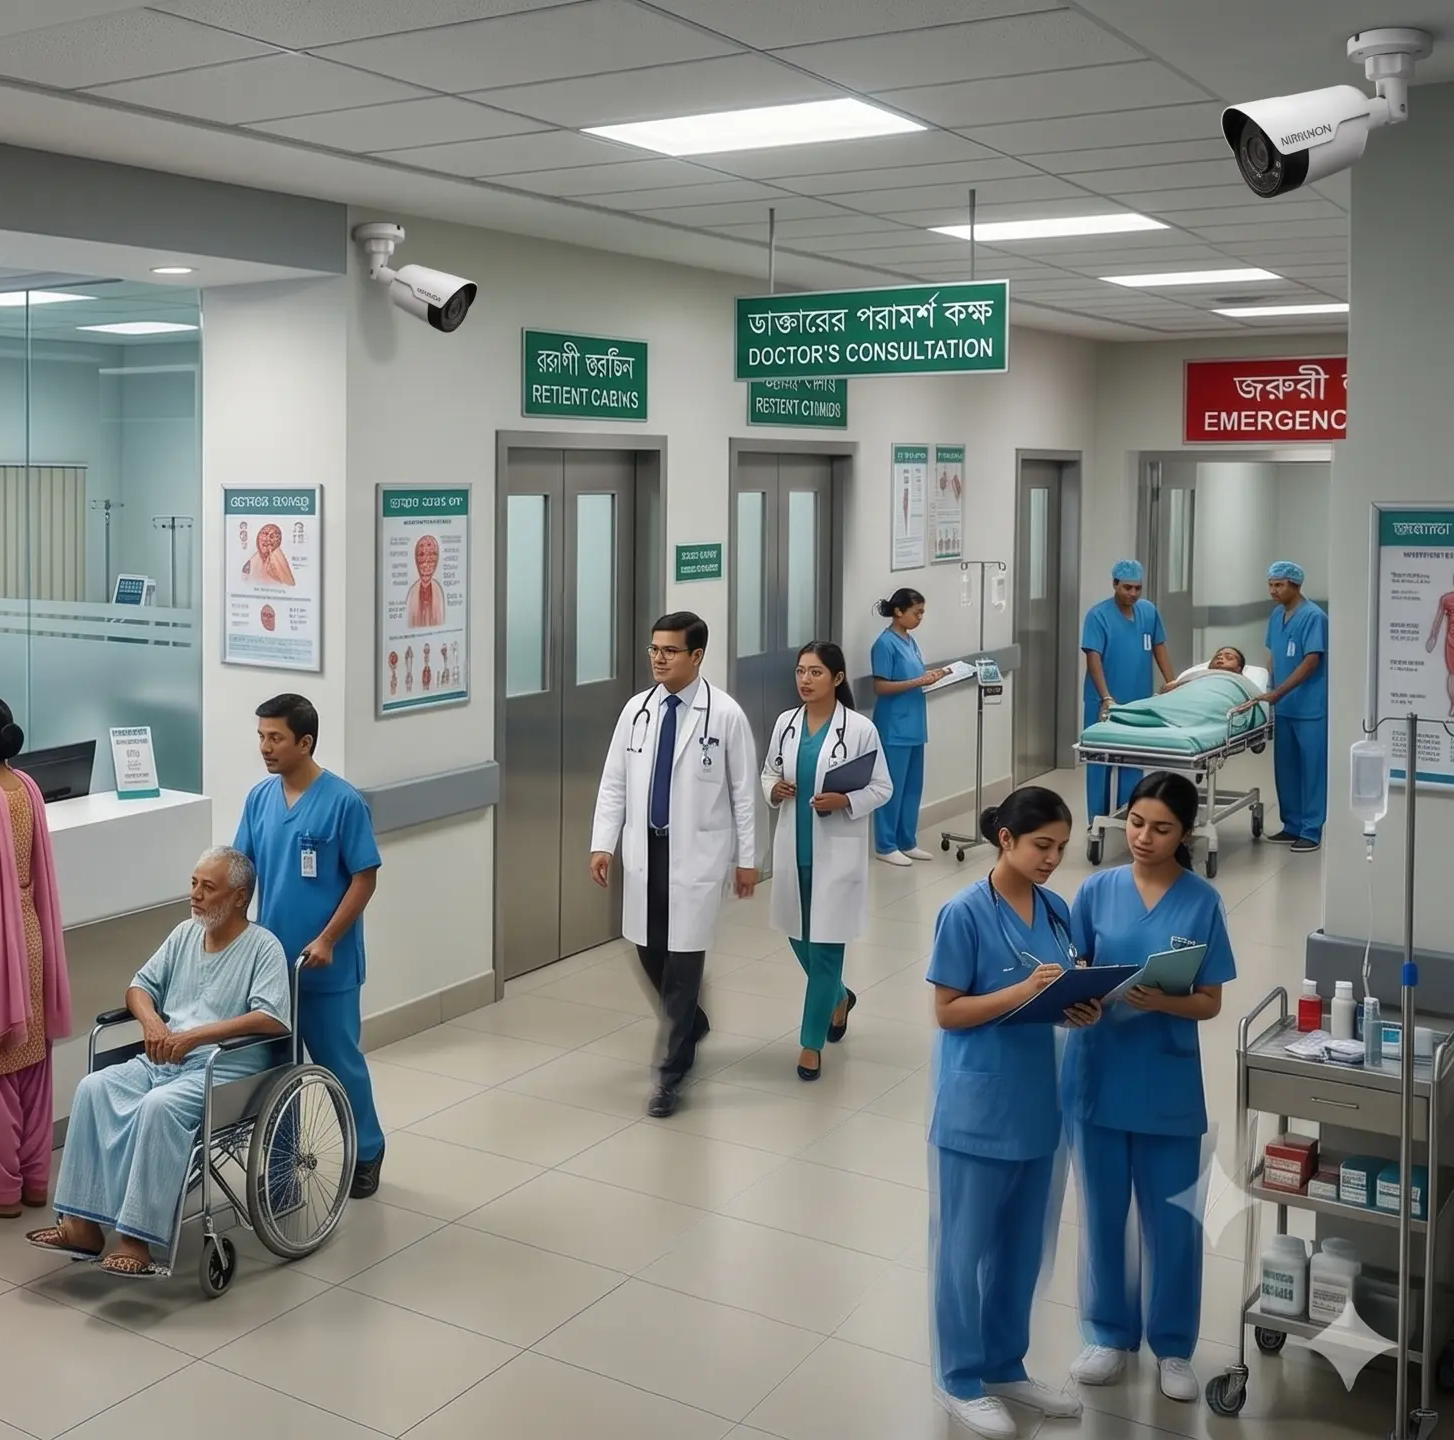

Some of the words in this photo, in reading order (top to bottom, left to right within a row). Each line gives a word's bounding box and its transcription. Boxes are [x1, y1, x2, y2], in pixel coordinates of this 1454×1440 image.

[747, 308, 849, 337] ডাক্তারের
[856, 291, 940, 331] পরামর্শ
[942, 300, 995, 327] কক্ষ
[748, 343, 841, 366] DOCTOR'S
[845, 337, 994, 364] CONSULTATION
[532, 384, 589, 406] RETIENT
[1233, 364, 1331, 402] জরুরী
